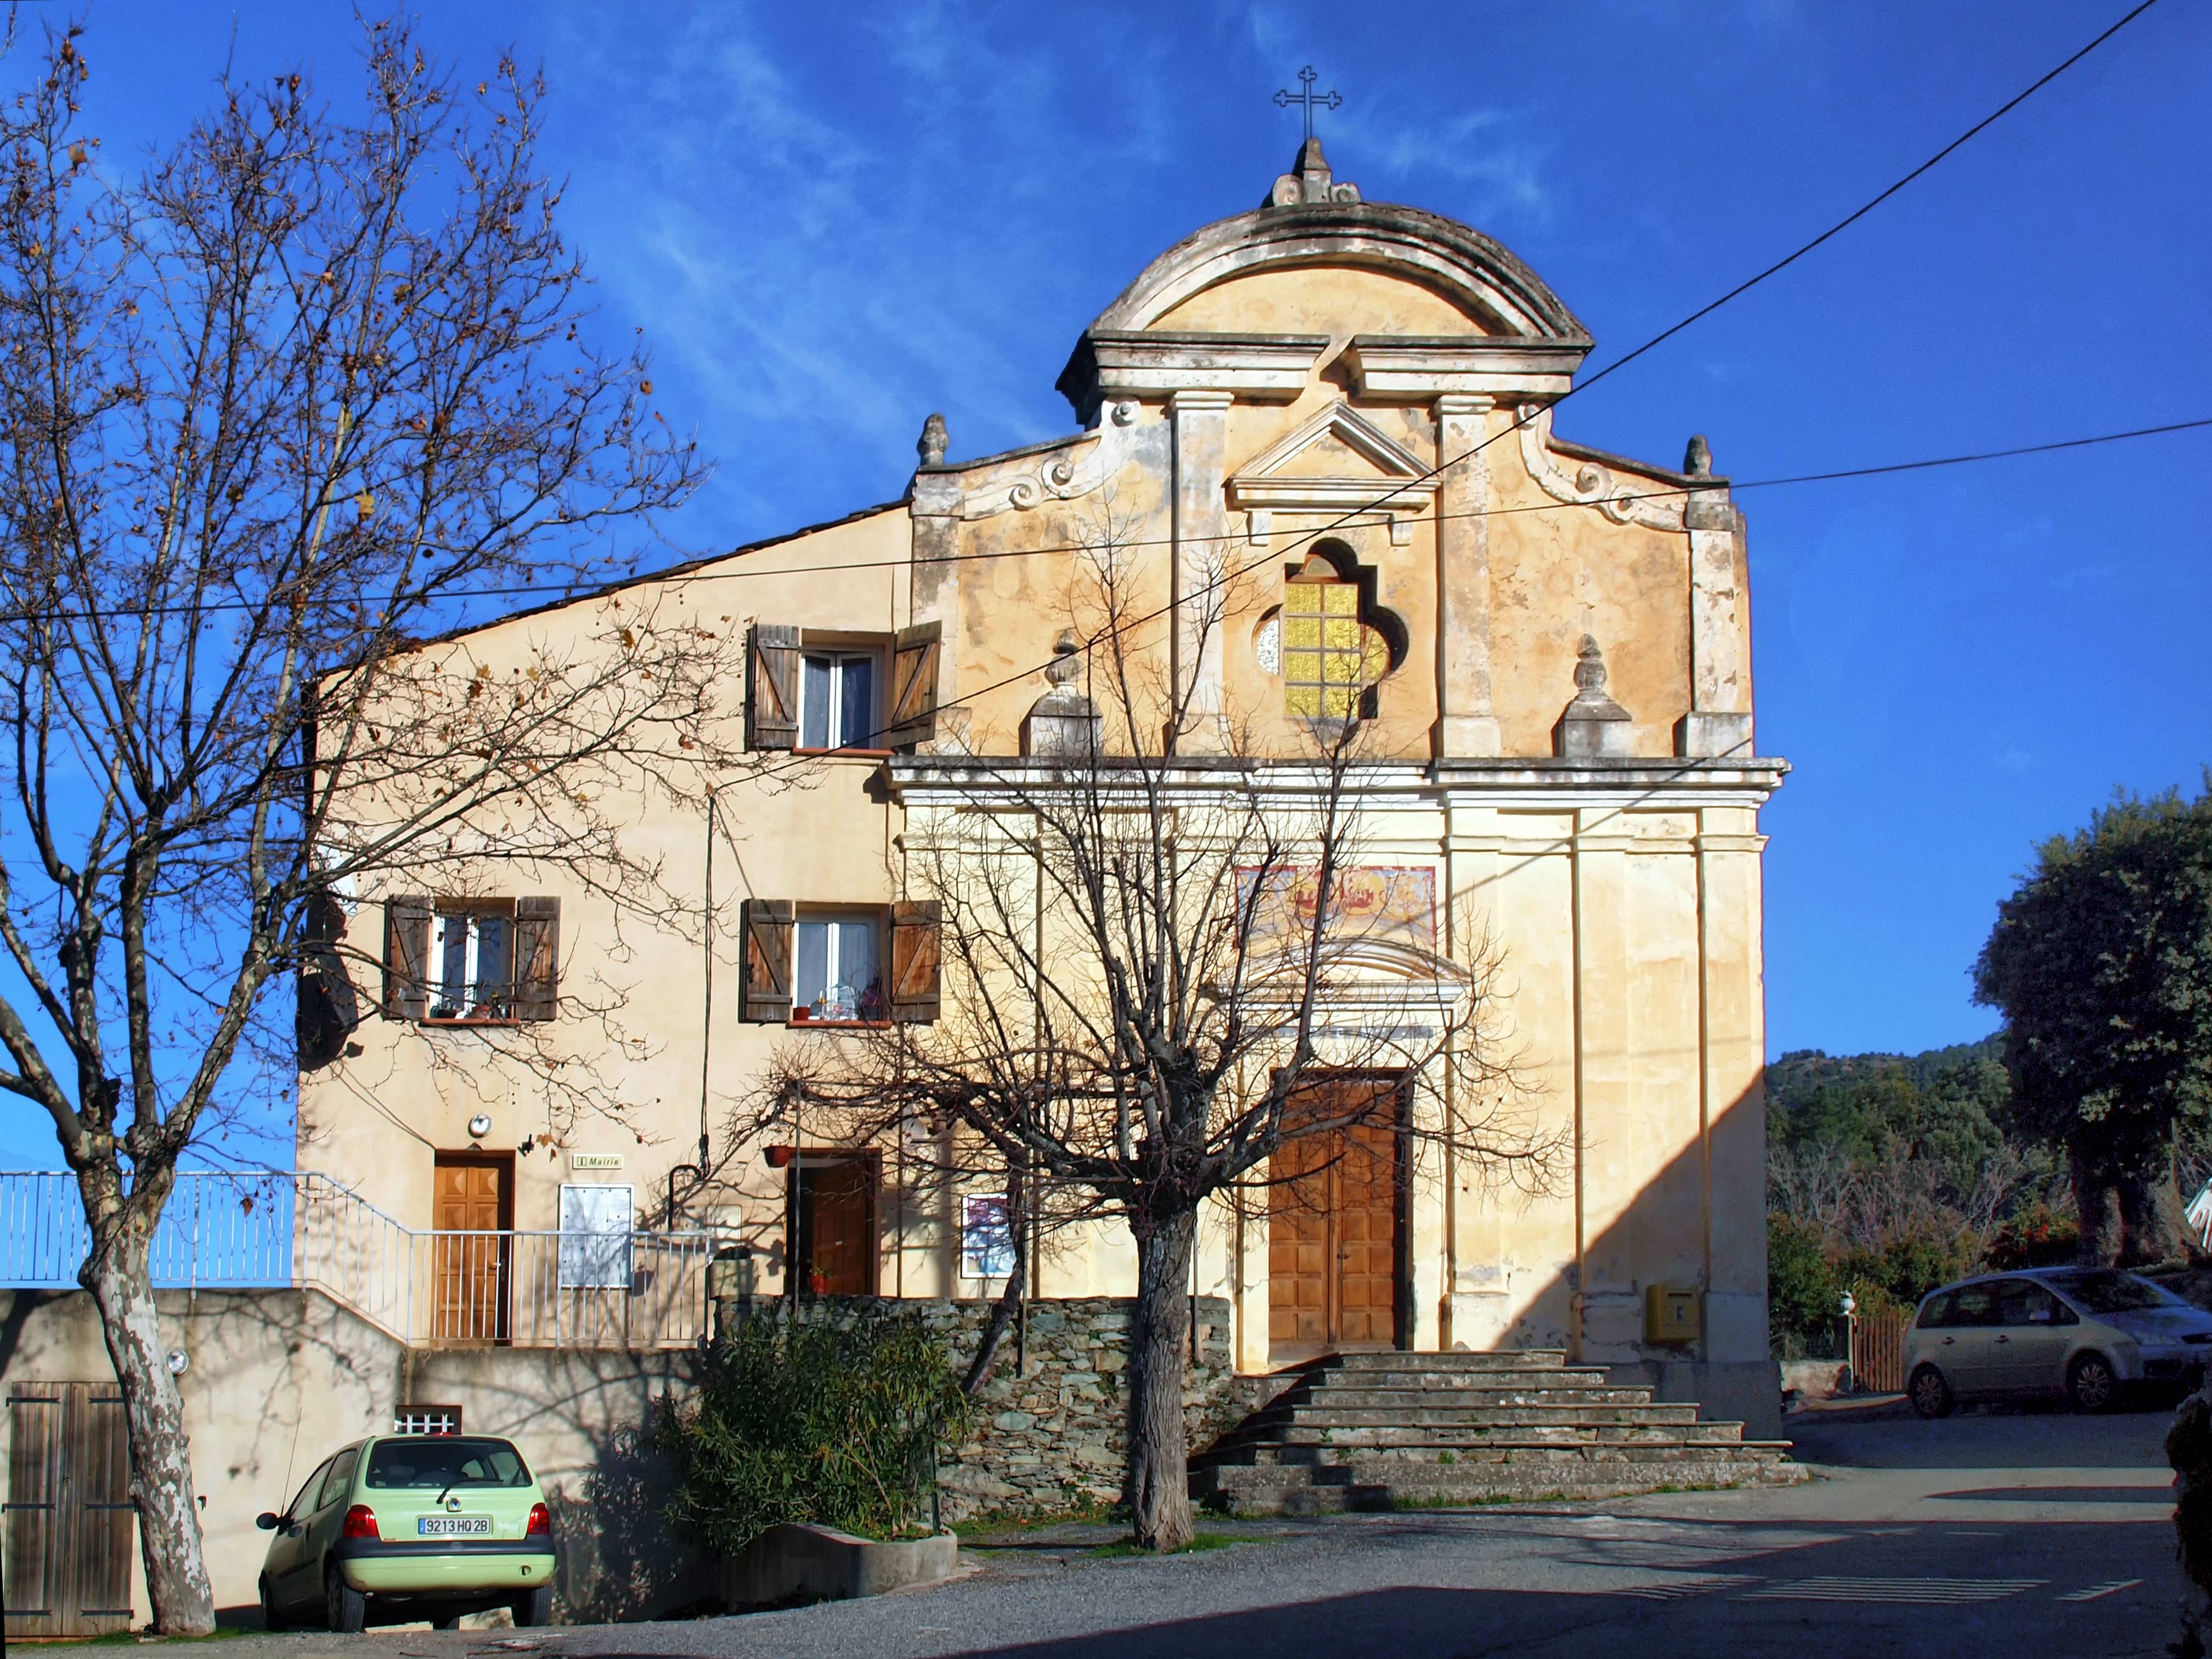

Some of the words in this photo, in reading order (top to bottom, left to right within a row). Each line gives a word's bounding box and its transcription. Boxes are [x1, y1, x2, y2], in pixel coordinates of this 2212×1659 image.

[427, 1520, 455, 1532] 9213
[458, 1520, 471, 1532] HQ
[474, 1520, 488, 1532] 2B
